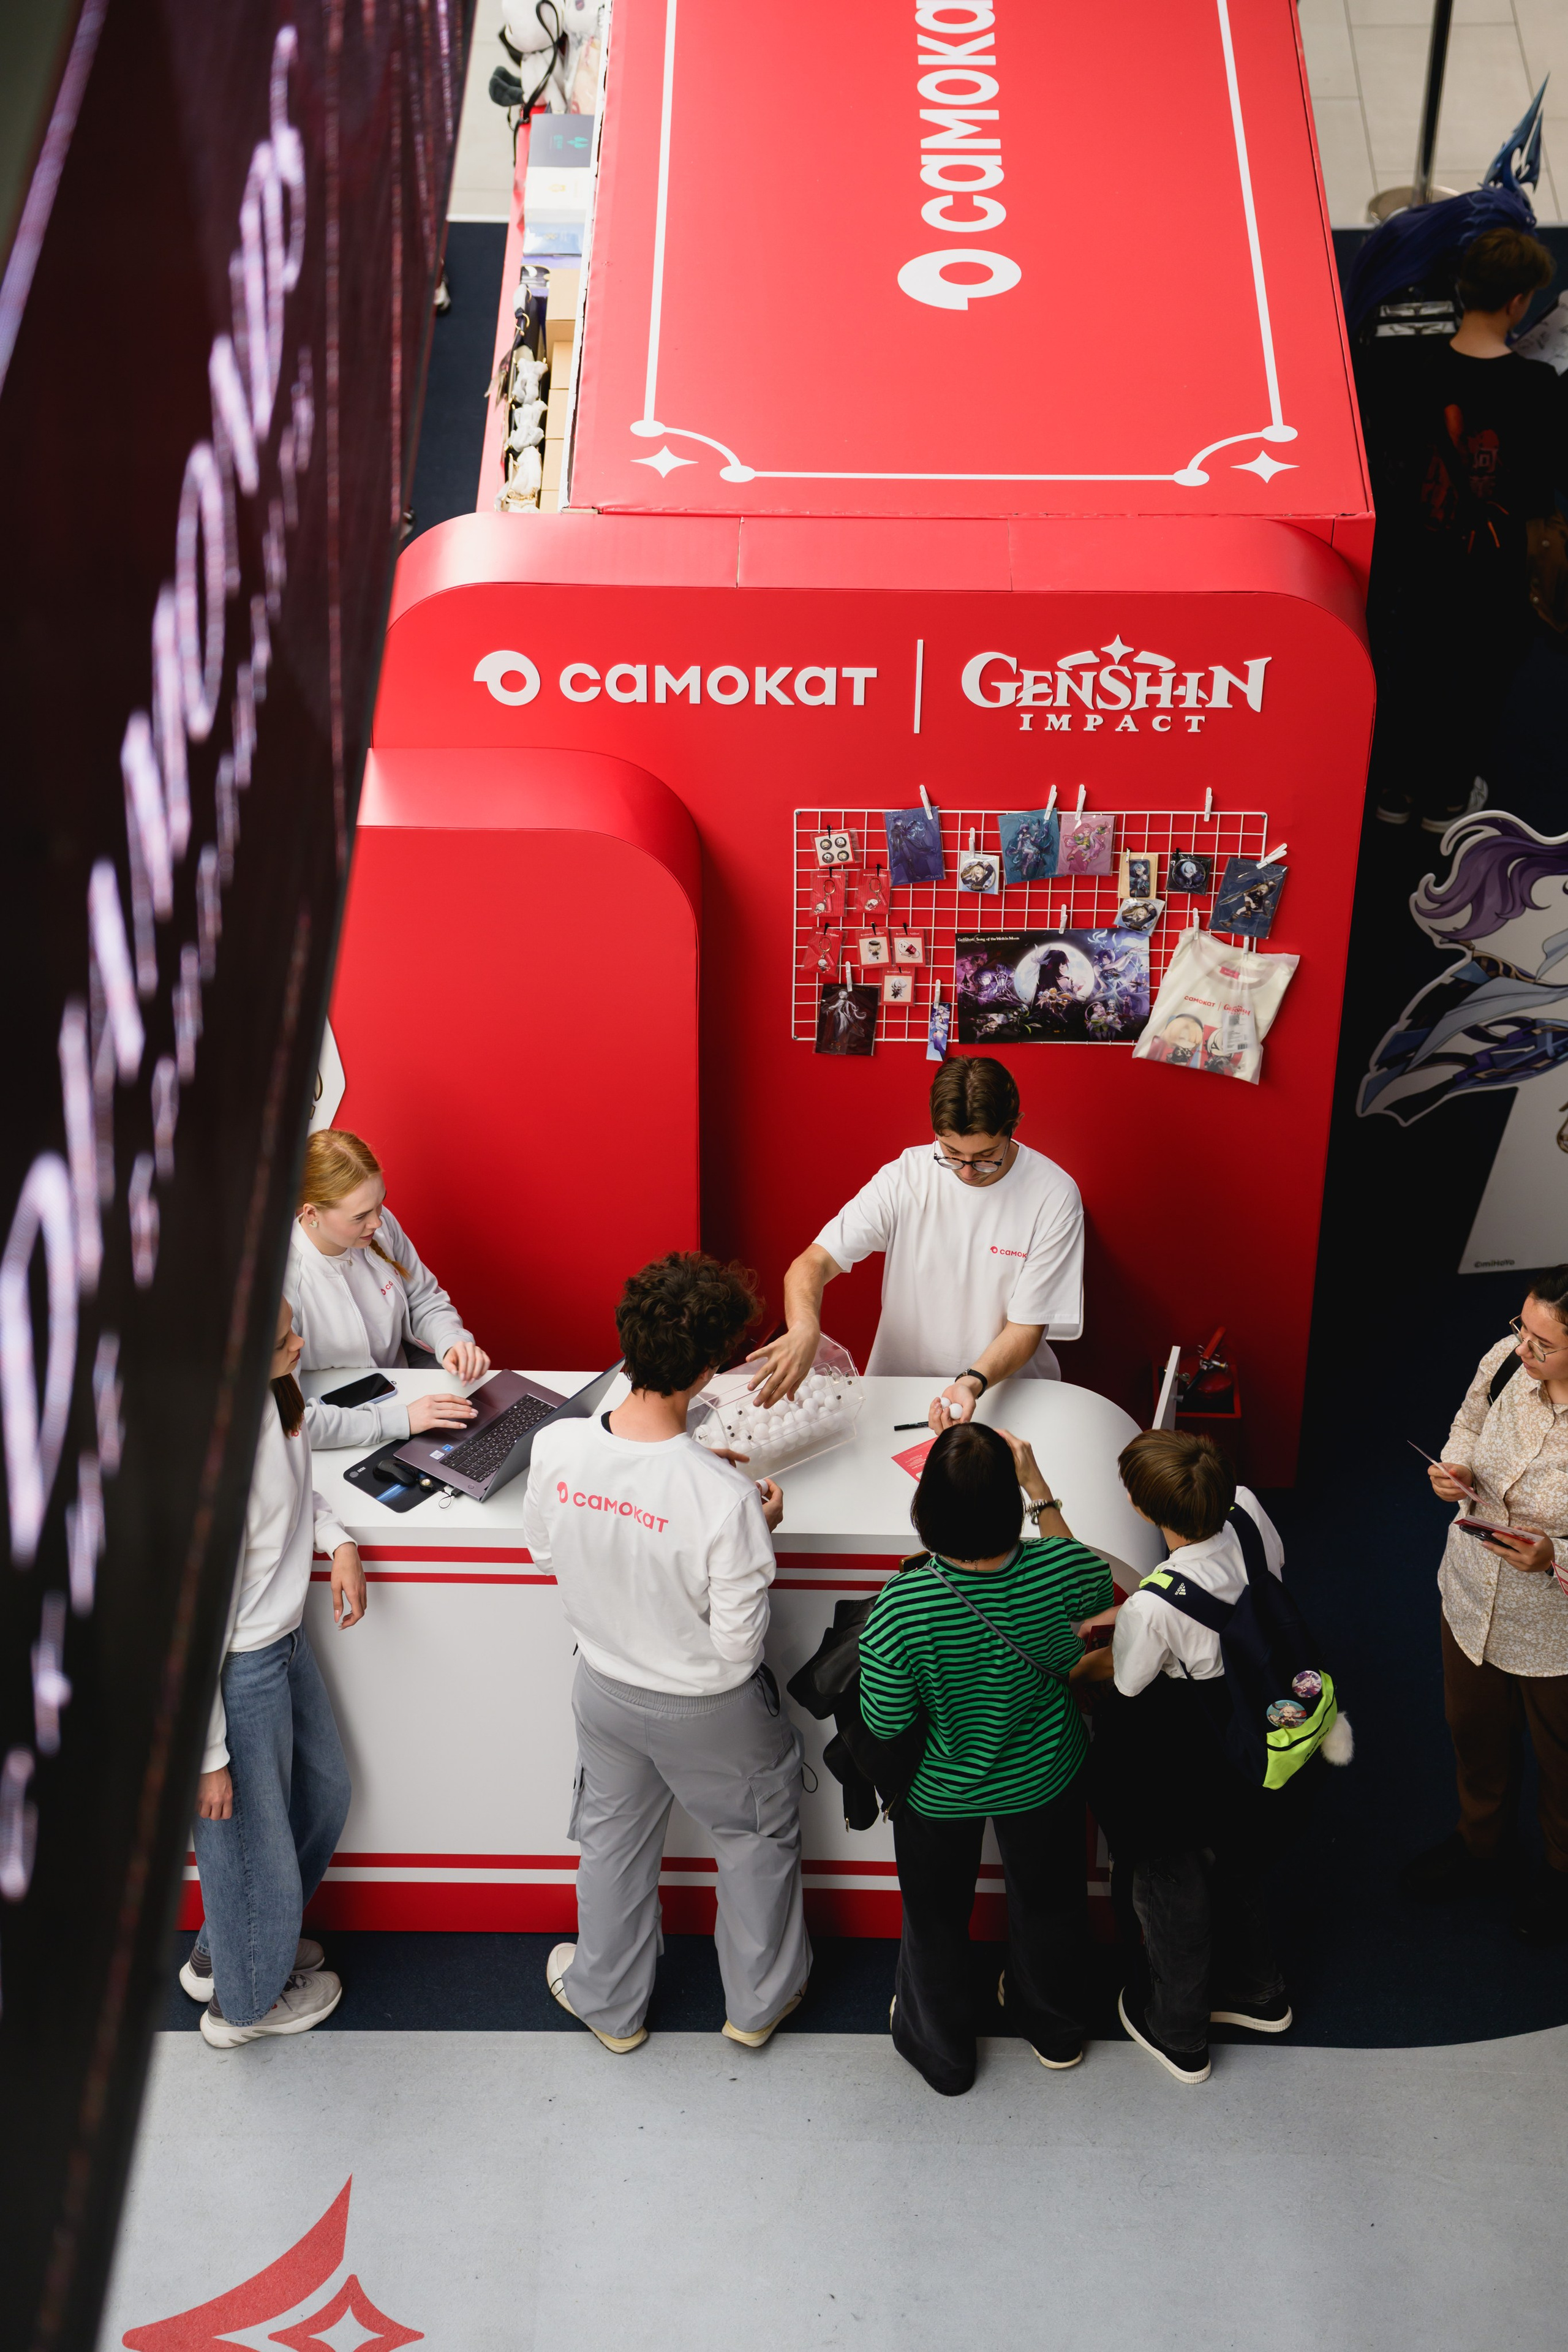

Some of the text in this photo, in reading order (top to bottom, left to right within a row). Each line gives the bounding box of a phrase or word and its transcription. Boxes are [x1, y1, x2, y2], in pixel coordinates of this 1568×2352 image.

[914, 0, 1006, 233] самока
[559, 662, 878, 706] самокат
[961, 651, 1272, 713] GENSHIN
[1019, 714, 1205, 733] IMPACT
[1184, 995, 1216, 1007] самокат
[999, 1249, 1028, 1258] самок
[573, 1491, 669, 1533] самокат
